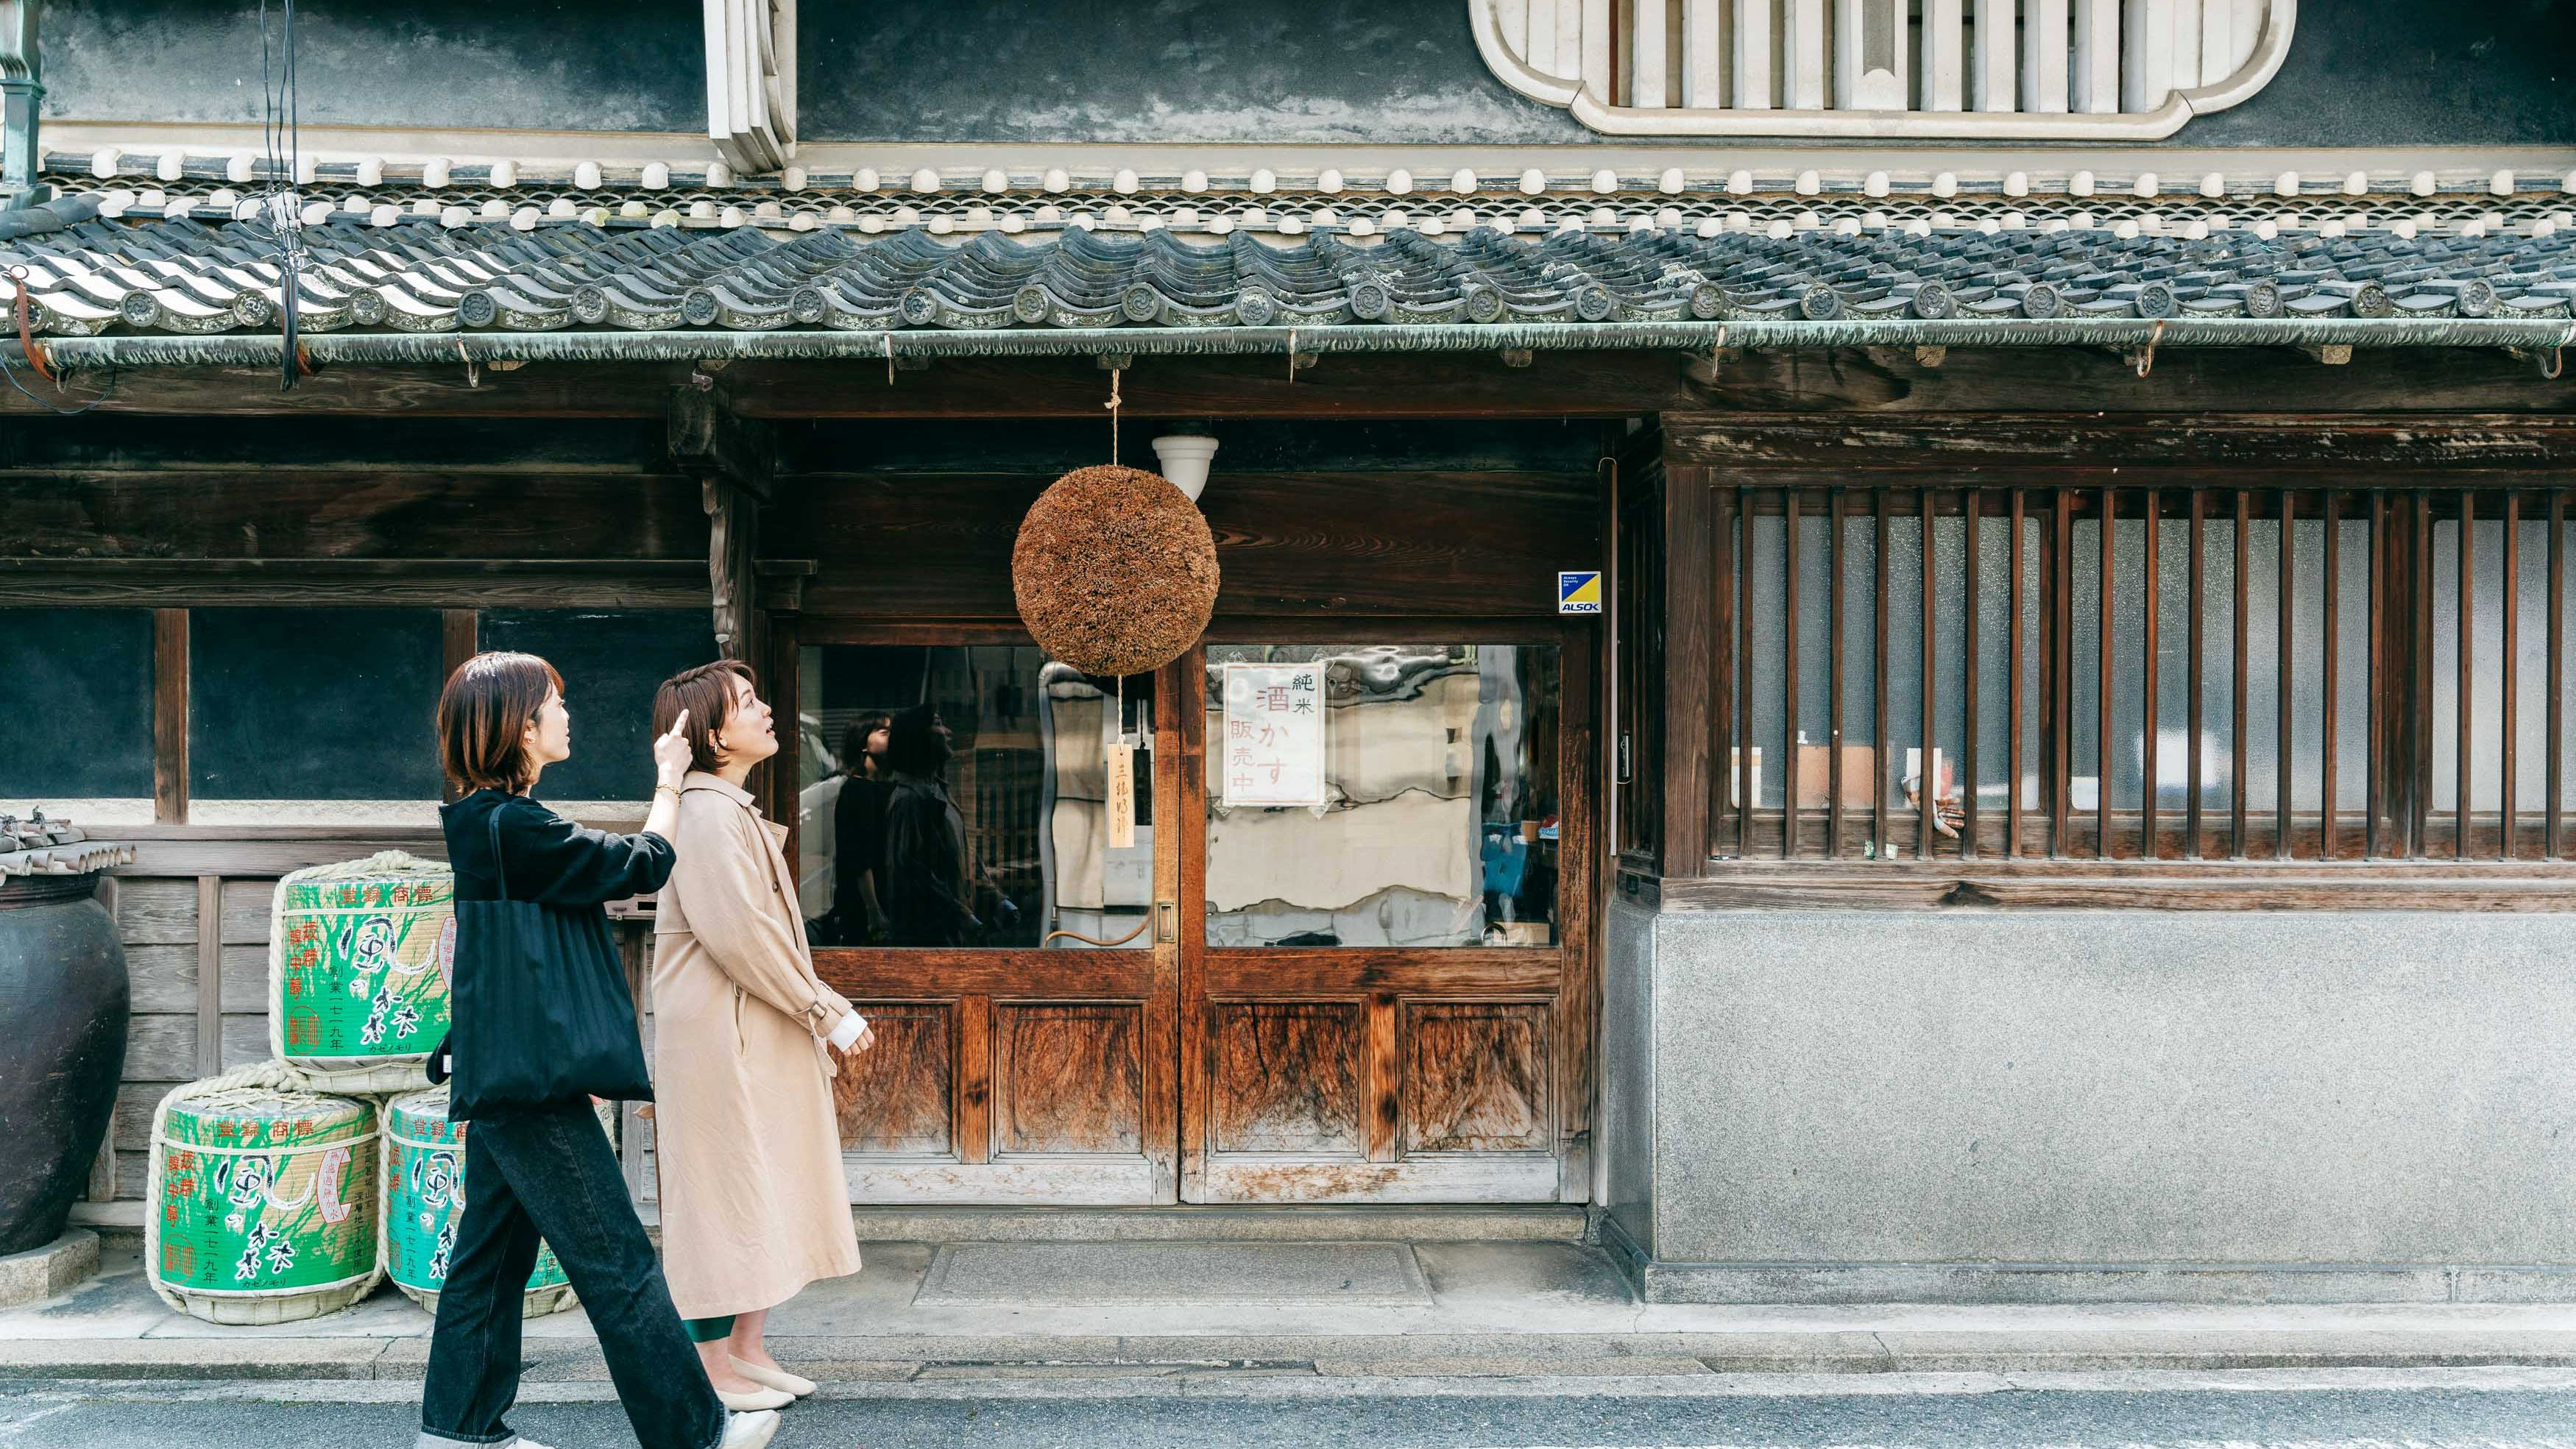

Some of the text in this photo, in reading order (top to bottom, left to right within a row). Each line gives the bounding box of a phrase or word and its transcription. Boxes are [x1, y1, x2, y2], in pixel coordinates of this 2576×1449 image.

[1256, 686, 1291, 786] 酒かす
[1292, 673, 1315, 715] 純米
[1230, 720, 1255, 793] 販売中
[329, 965, 344, 1052] 創業一七一九年
[339, 917, 436, 1045] 風の森
[369, 1044, 412, 1053] カゼノモリ
[202, 1198, 219, 1284] 創業一七一九年
[215, 1153, 316, 1280] 風の森
[406, 1195, 417, 1280] 創業一七一九年
[241, 1278, 287, 1289] カゼノモリ
